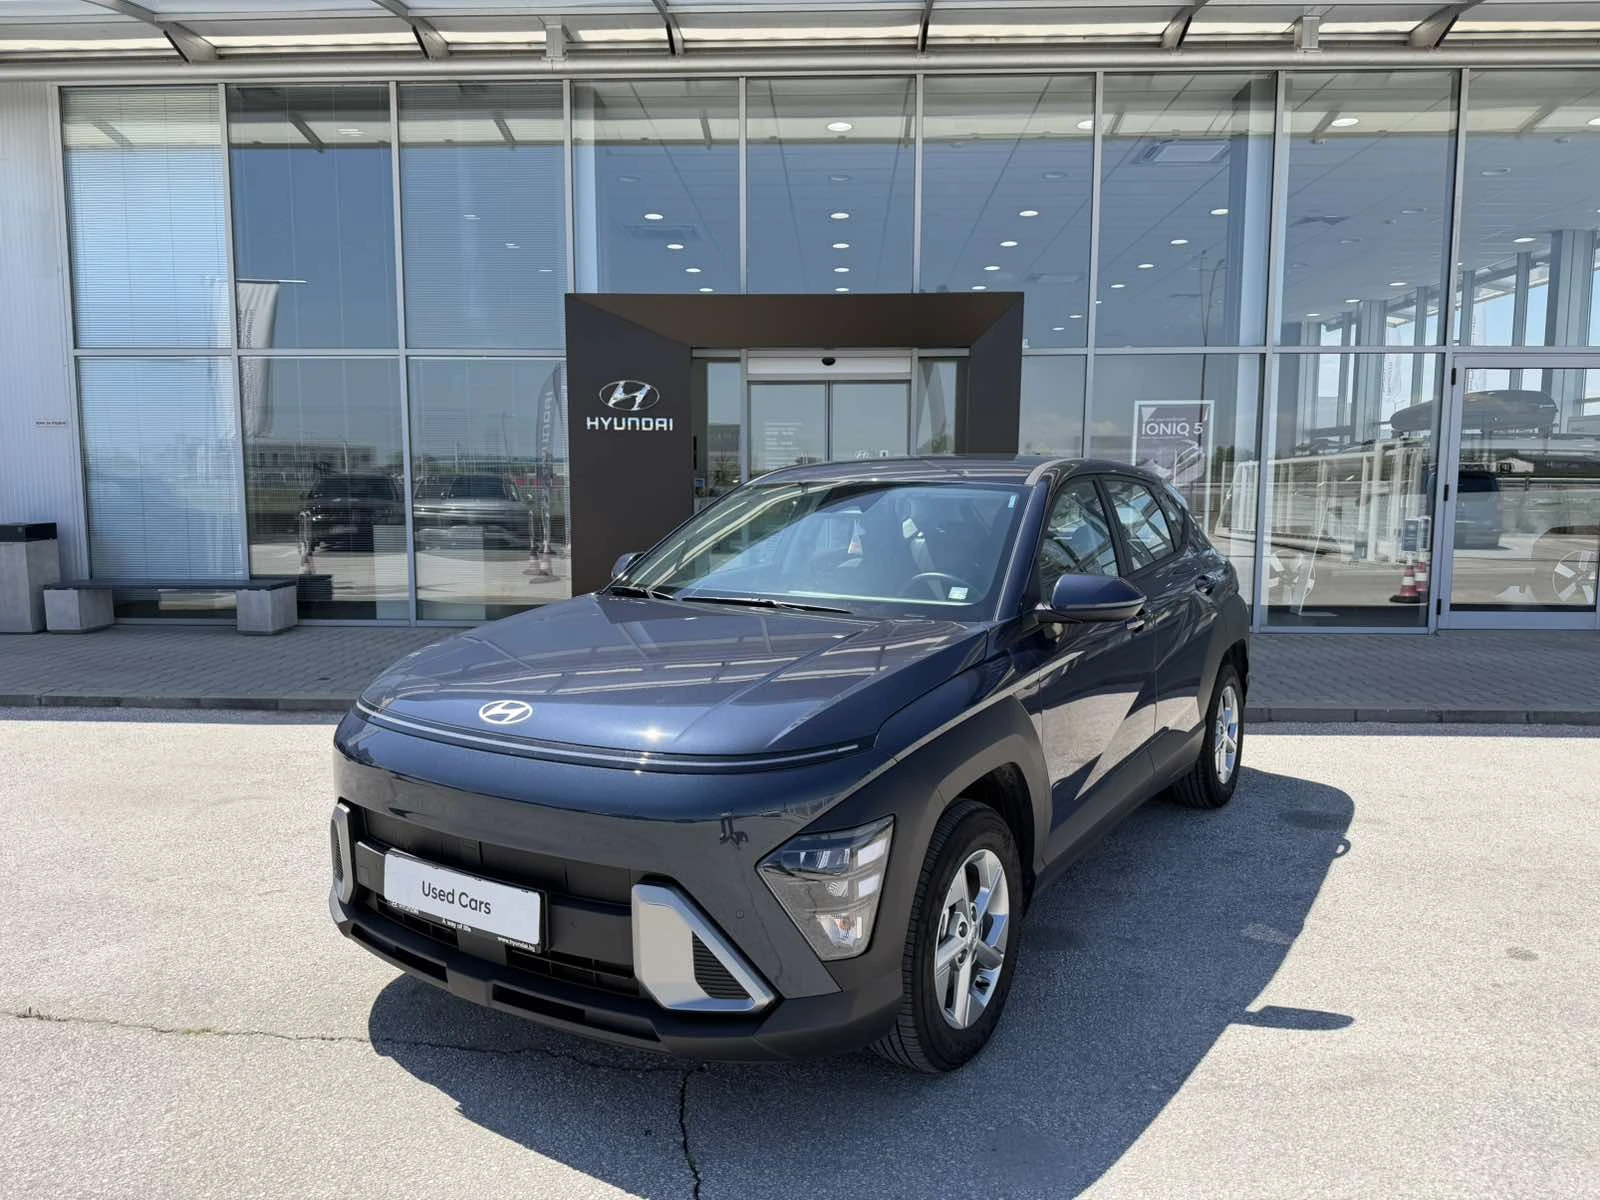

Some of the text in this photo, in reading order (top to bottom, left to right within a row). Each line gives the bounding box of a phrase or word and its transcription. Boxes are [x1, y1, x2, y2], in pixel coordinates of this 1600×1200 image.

[586, 416, 673, 431] HYUNDAI
[1142, 421, 1204, 437] IONIQ 5
[422, 880, 491, 915] Used Cars
